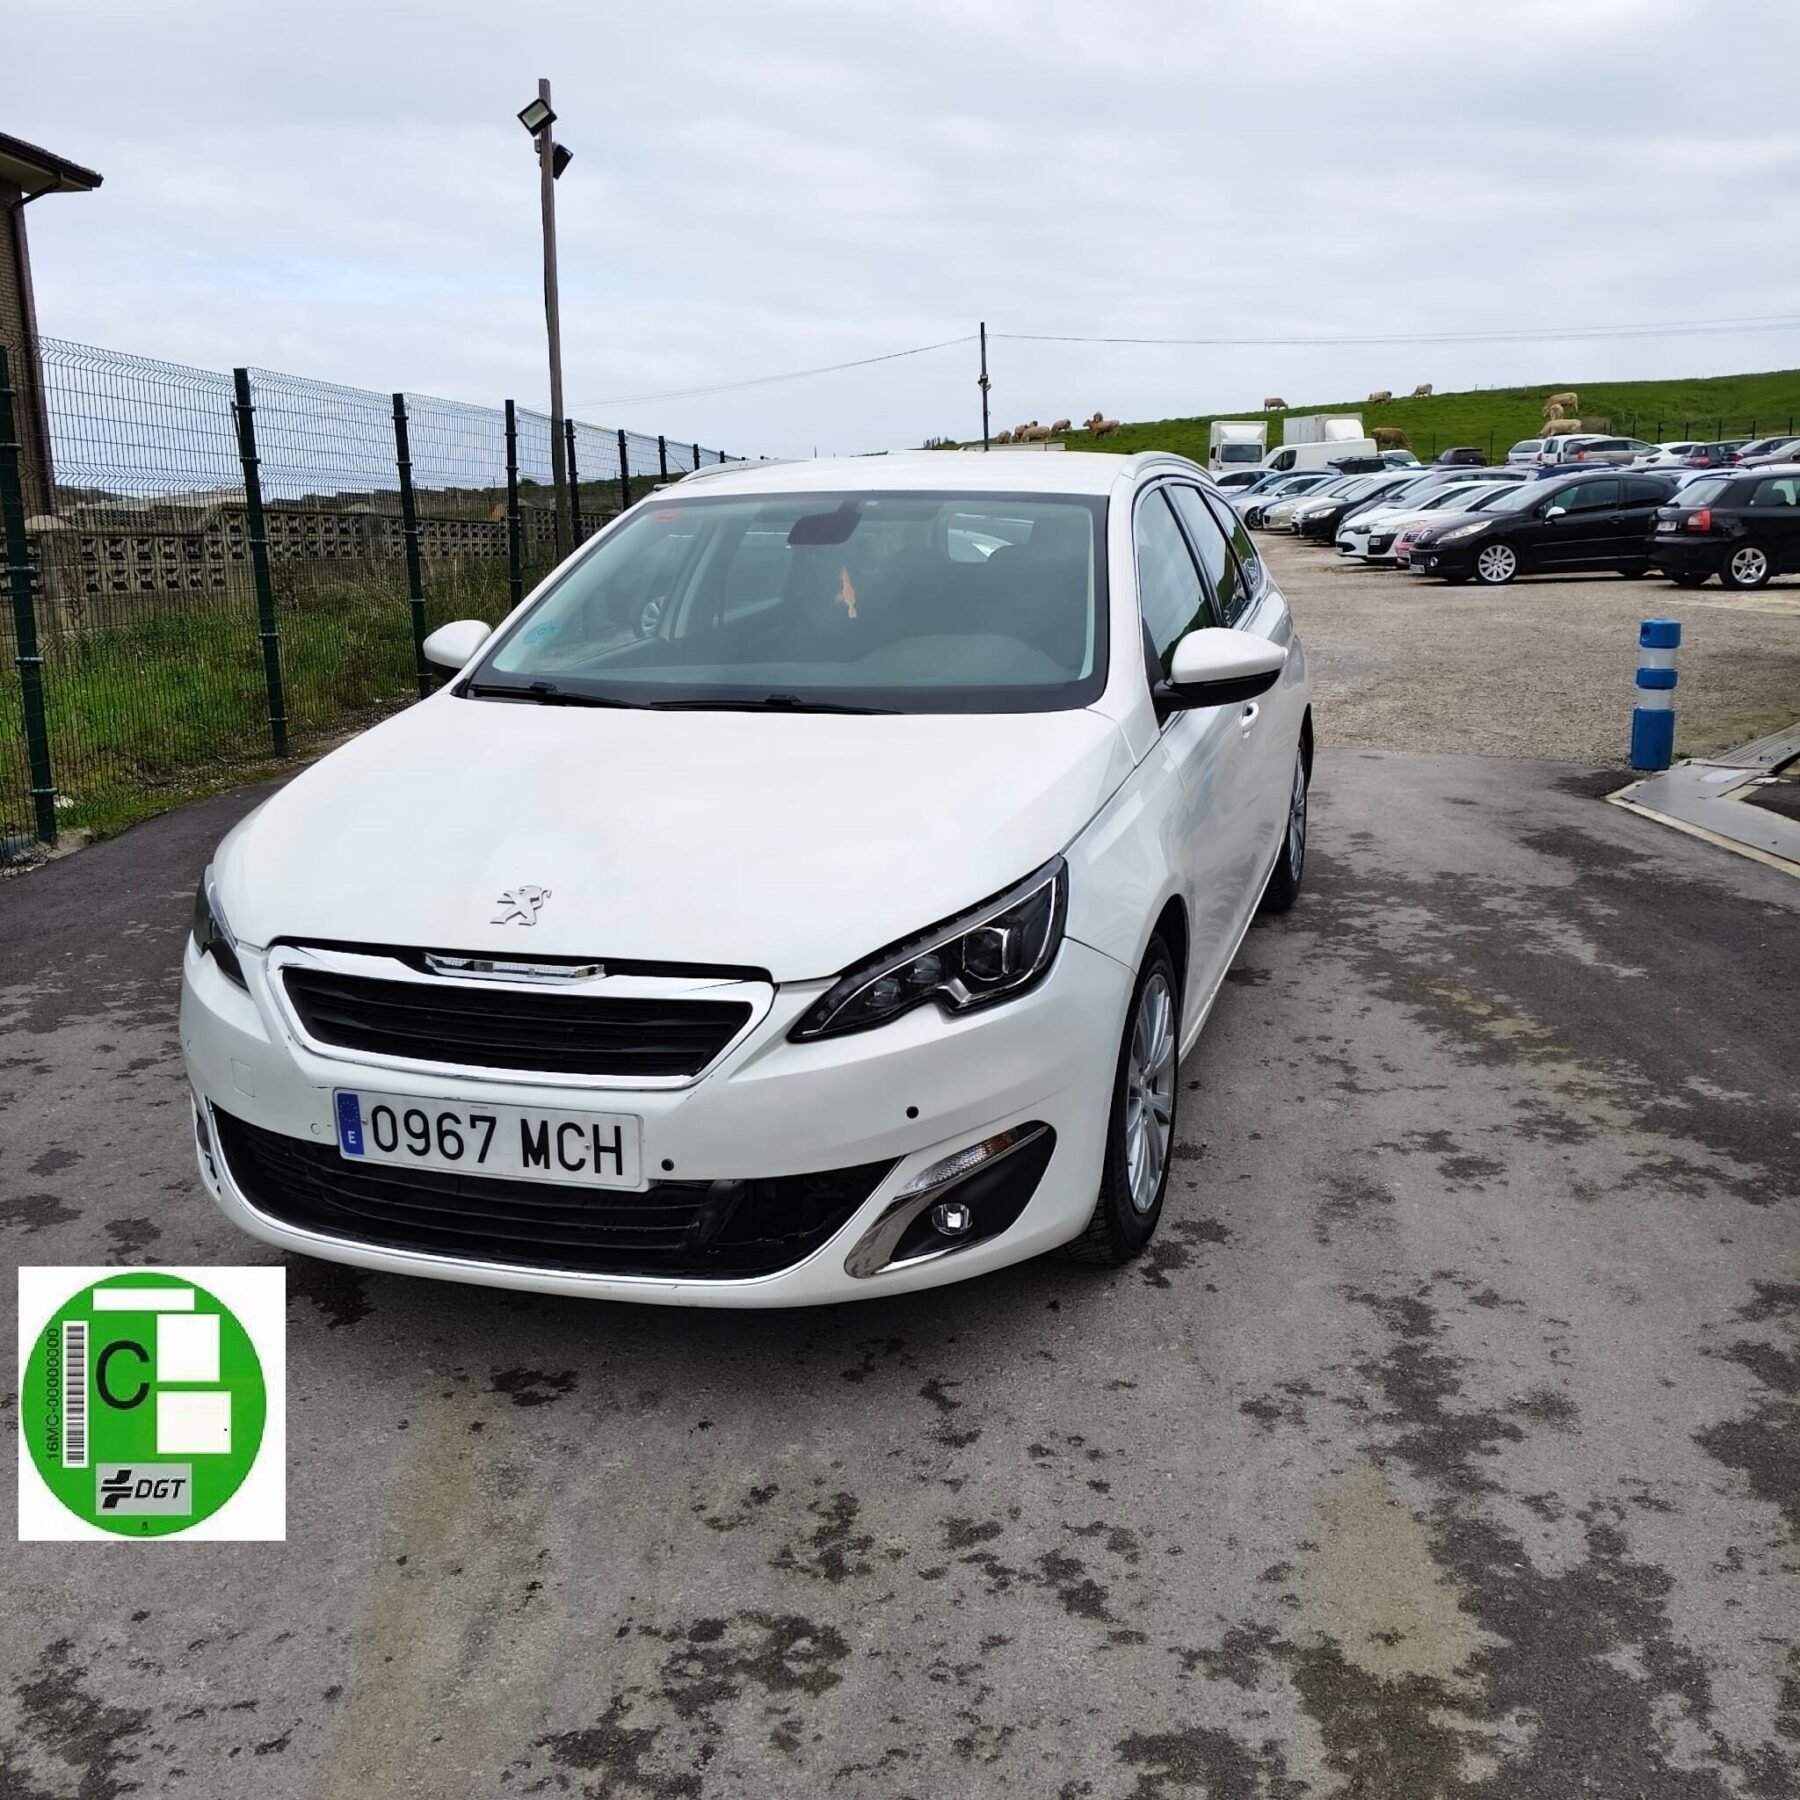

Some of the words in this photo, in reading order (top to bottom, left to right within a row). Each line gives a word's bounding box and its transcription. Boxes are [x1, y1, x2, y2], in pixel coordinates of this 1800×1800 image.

[347, 1130, 357, 1145] E
[371, 1104, 497, 1164] 0967
[520, 1118, 623, 1176] MCH
